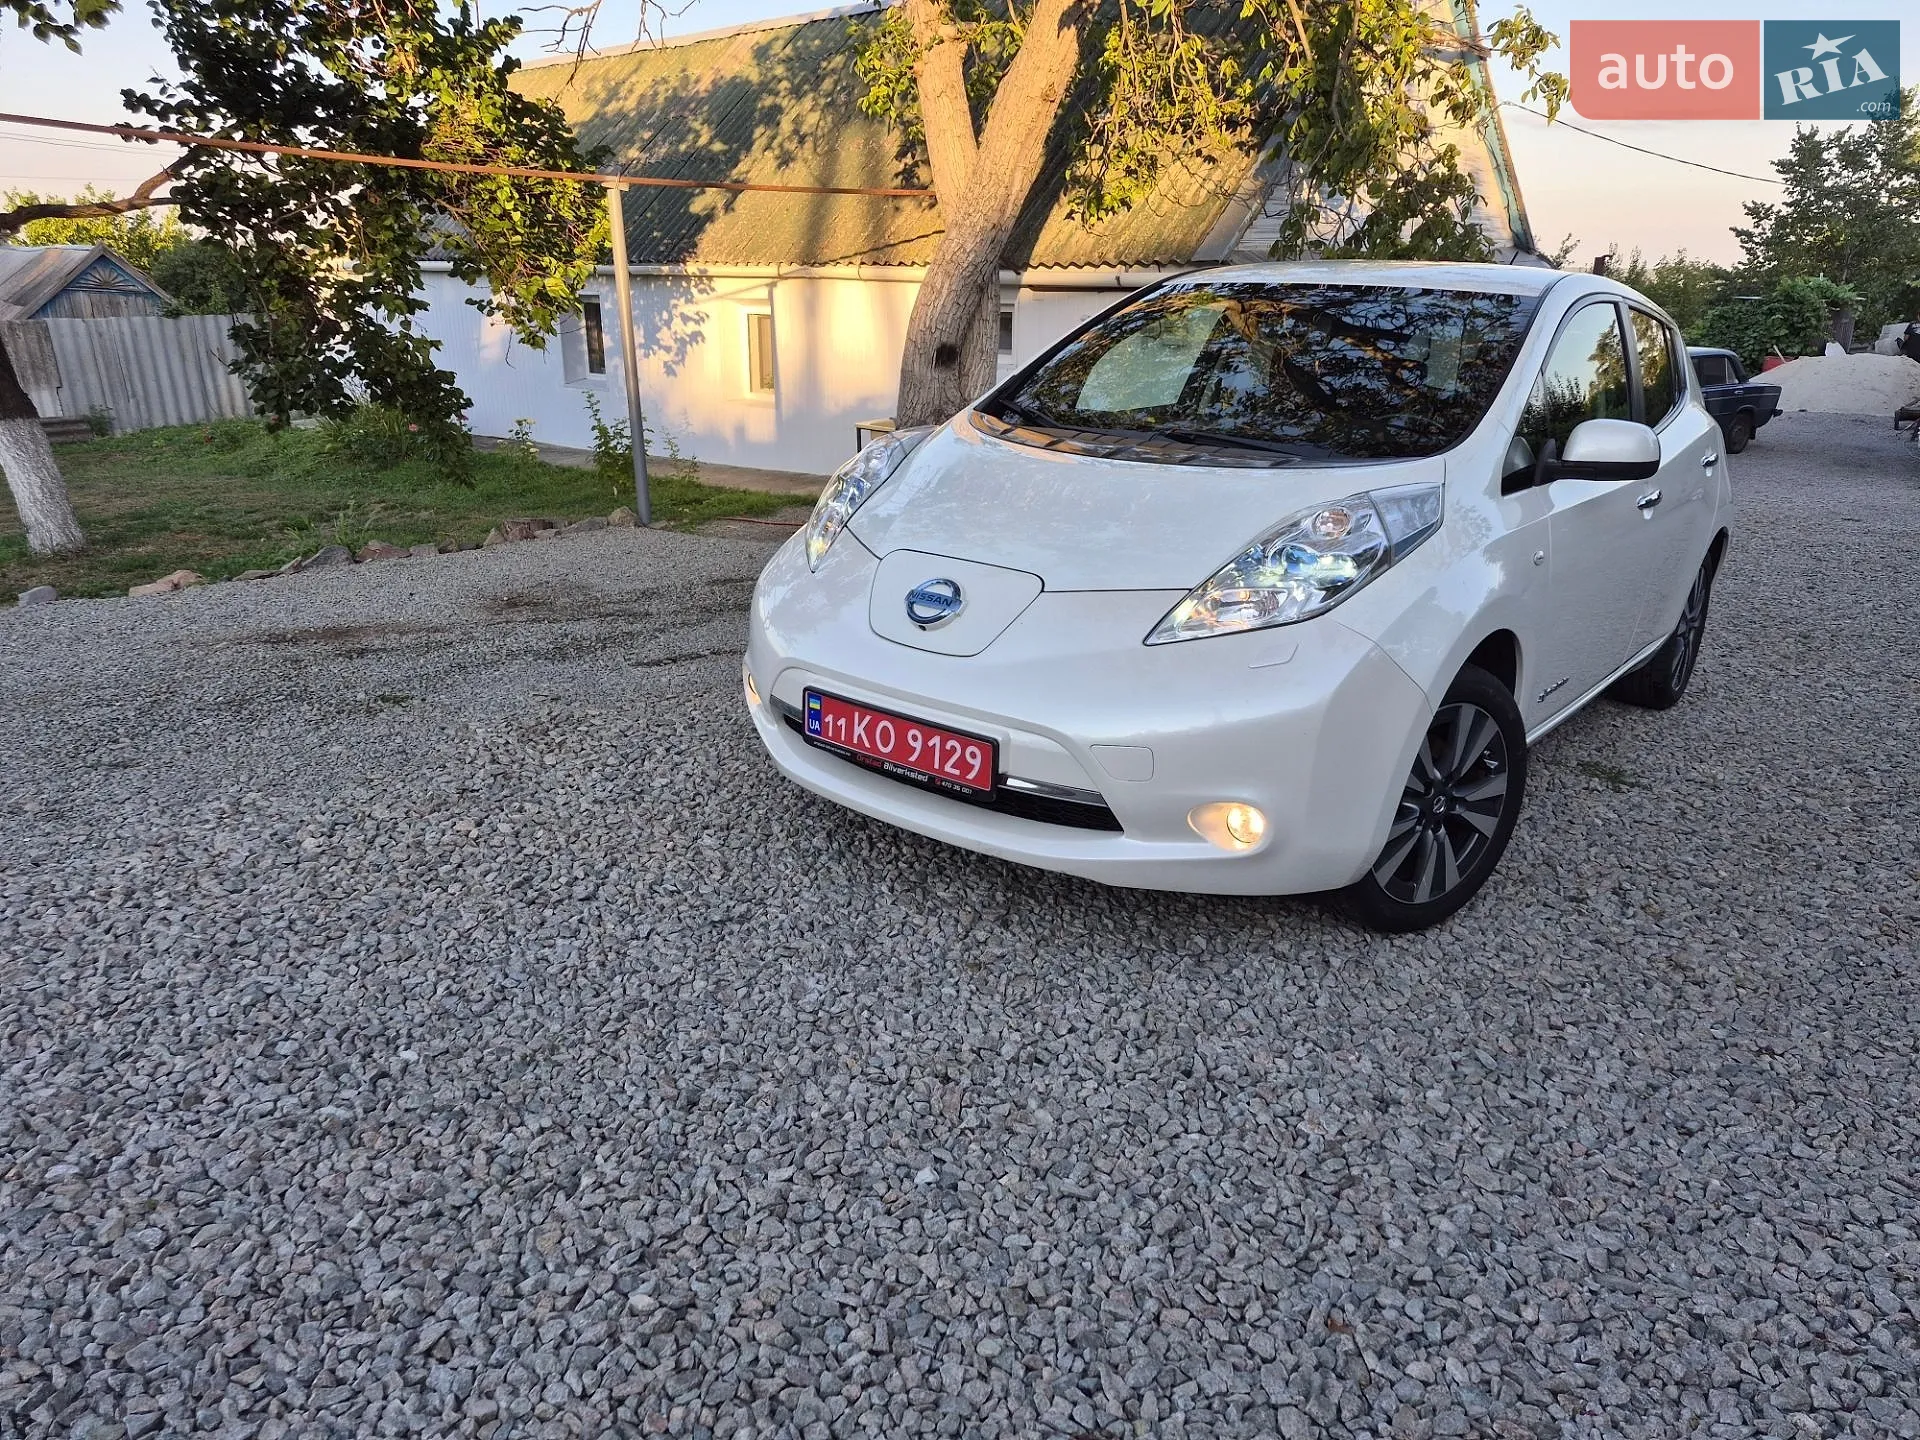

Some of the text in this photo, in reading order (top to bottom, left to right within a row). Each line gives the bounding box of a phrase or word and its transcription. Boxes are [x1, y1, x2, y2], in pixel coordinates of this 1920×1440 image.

[908, 591, 953, 607] NISSAN
[809, 717, 821, 732] UA
[906, 728, 983, 780] 9129
